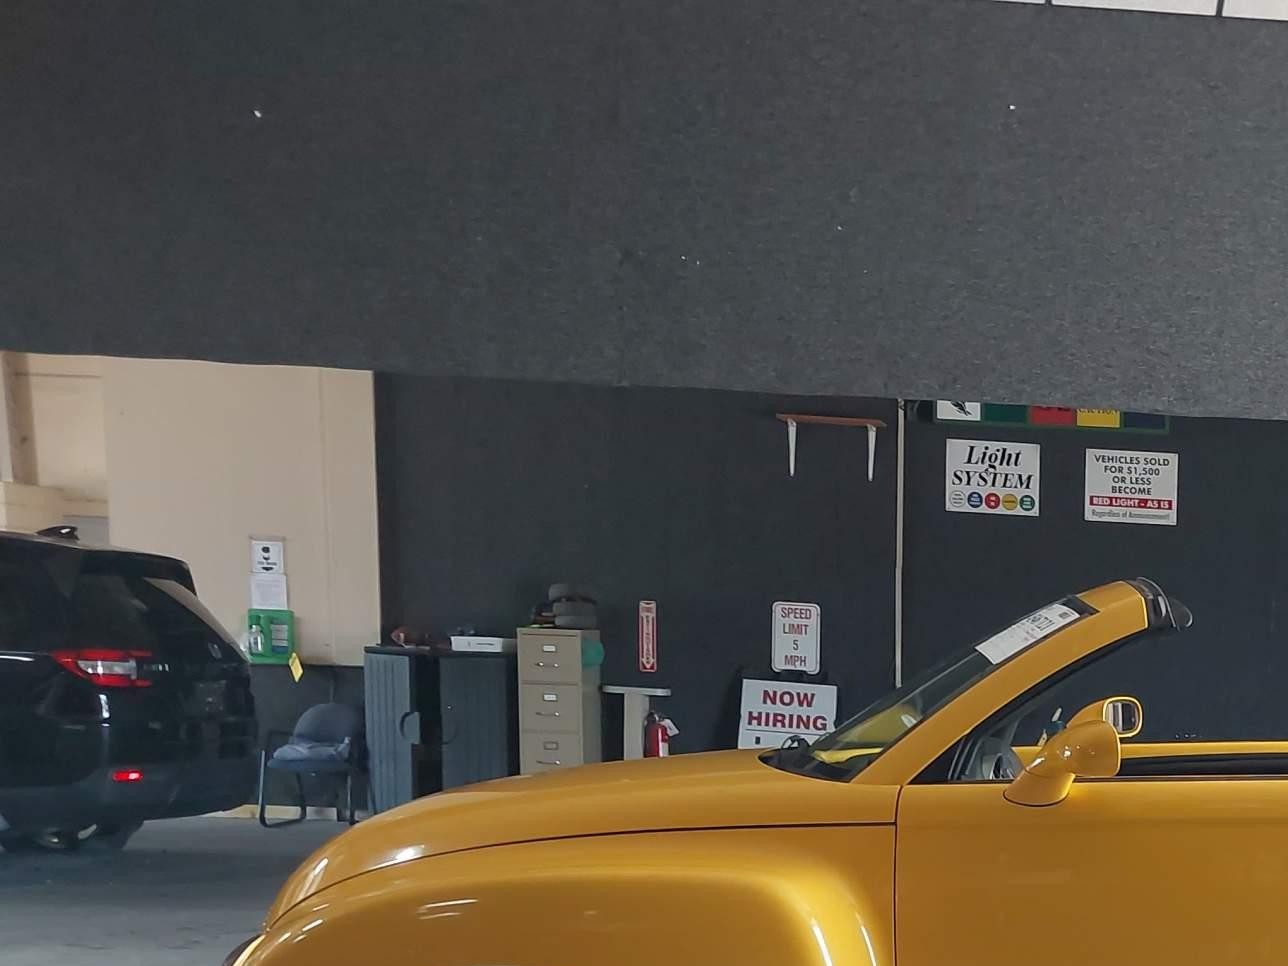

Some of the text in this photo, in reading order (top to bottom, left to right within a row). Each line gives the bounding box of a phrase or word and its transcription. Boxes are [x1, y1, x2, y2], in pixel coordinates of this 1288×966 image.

[964, 445, 1022, 474] Light
[1094, 454, 1170, 467] VEHICLES SOLD
[1104, 465, 1160, 476] FOR $1,500
[951, 469, 1034, 490] SYSTEM
[1112, 475, 1152, 486] OR LESS
[1111, 485, 1152, 496] BECOME
[1092, 497, 1111, 506] RED
[1112, 498, 1139, 507] LIGHT
[1146, 500, 1159, 509] AS
[1160, 501, 1169, 509] IS
[780, 607, 813, 620] SPEED
[782, 623, 809, 636] LIMIT
[792, 639, 800, 651] 5
[784, 655, 807, 668] MPH
[761, 689, 817, 708] NOW
[747, 710, 828, 732] HIRING
